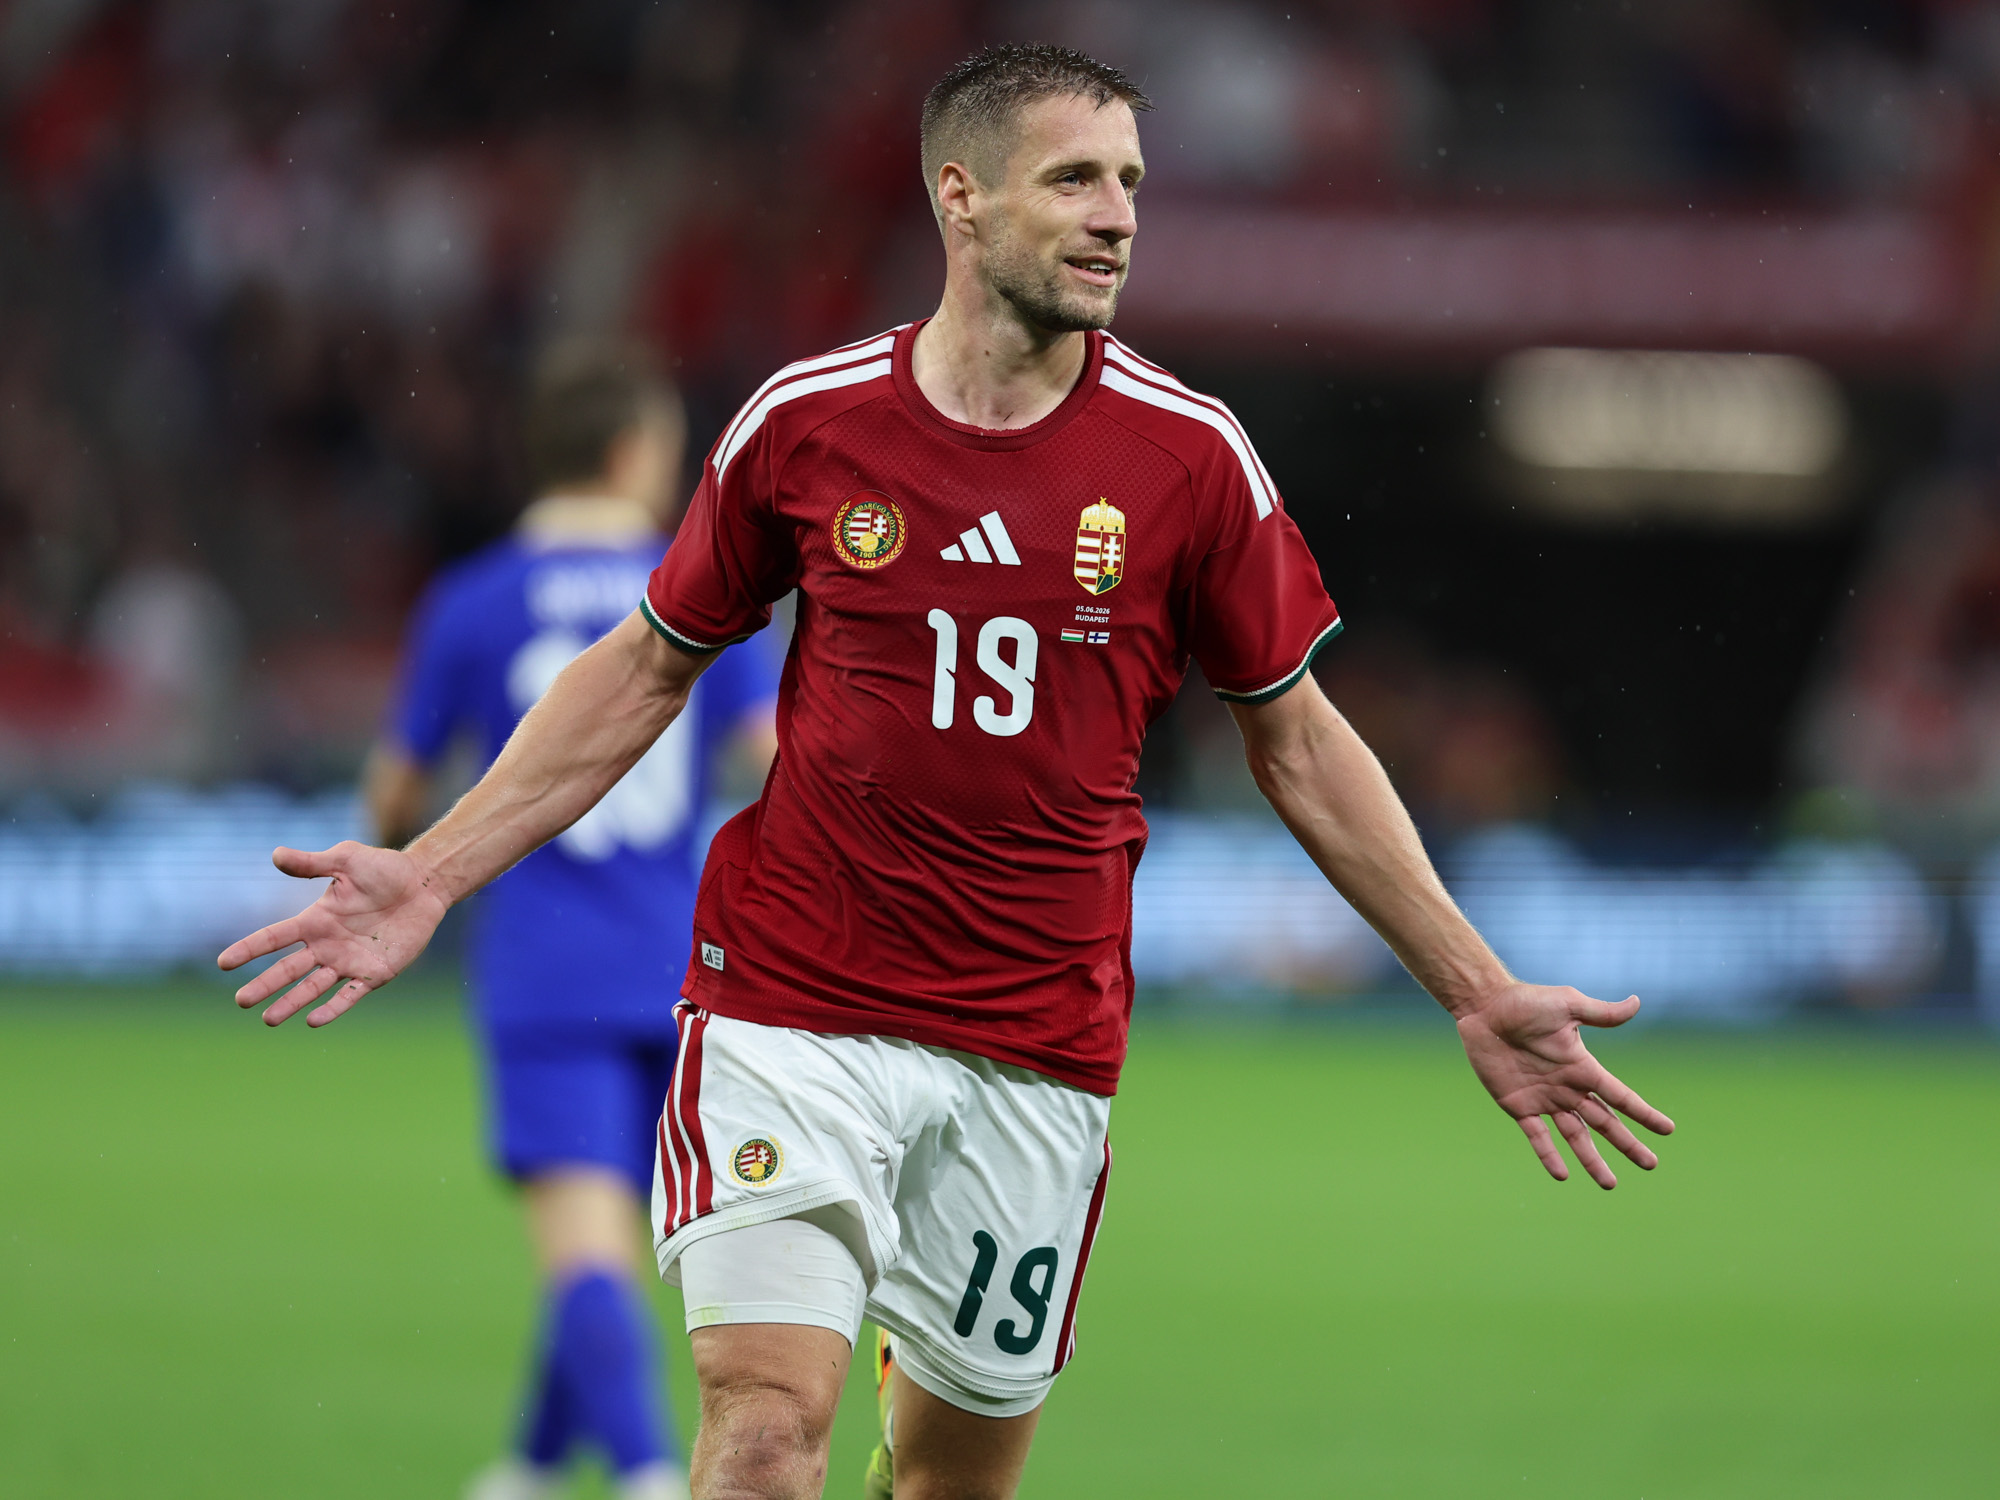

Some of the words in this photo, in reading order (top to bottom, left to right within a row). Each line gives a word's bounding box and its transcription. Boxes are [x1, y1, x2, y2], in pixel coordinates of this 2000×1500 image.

[858, 560, 876, 569] 125
[1076, 605, 1110, 614] 05.06.2026
[1075, 614, 1109, 623] BUDAPEST
[928, 608, 1038, 736] 19
[954, 1230, 1058, 1355] 19
